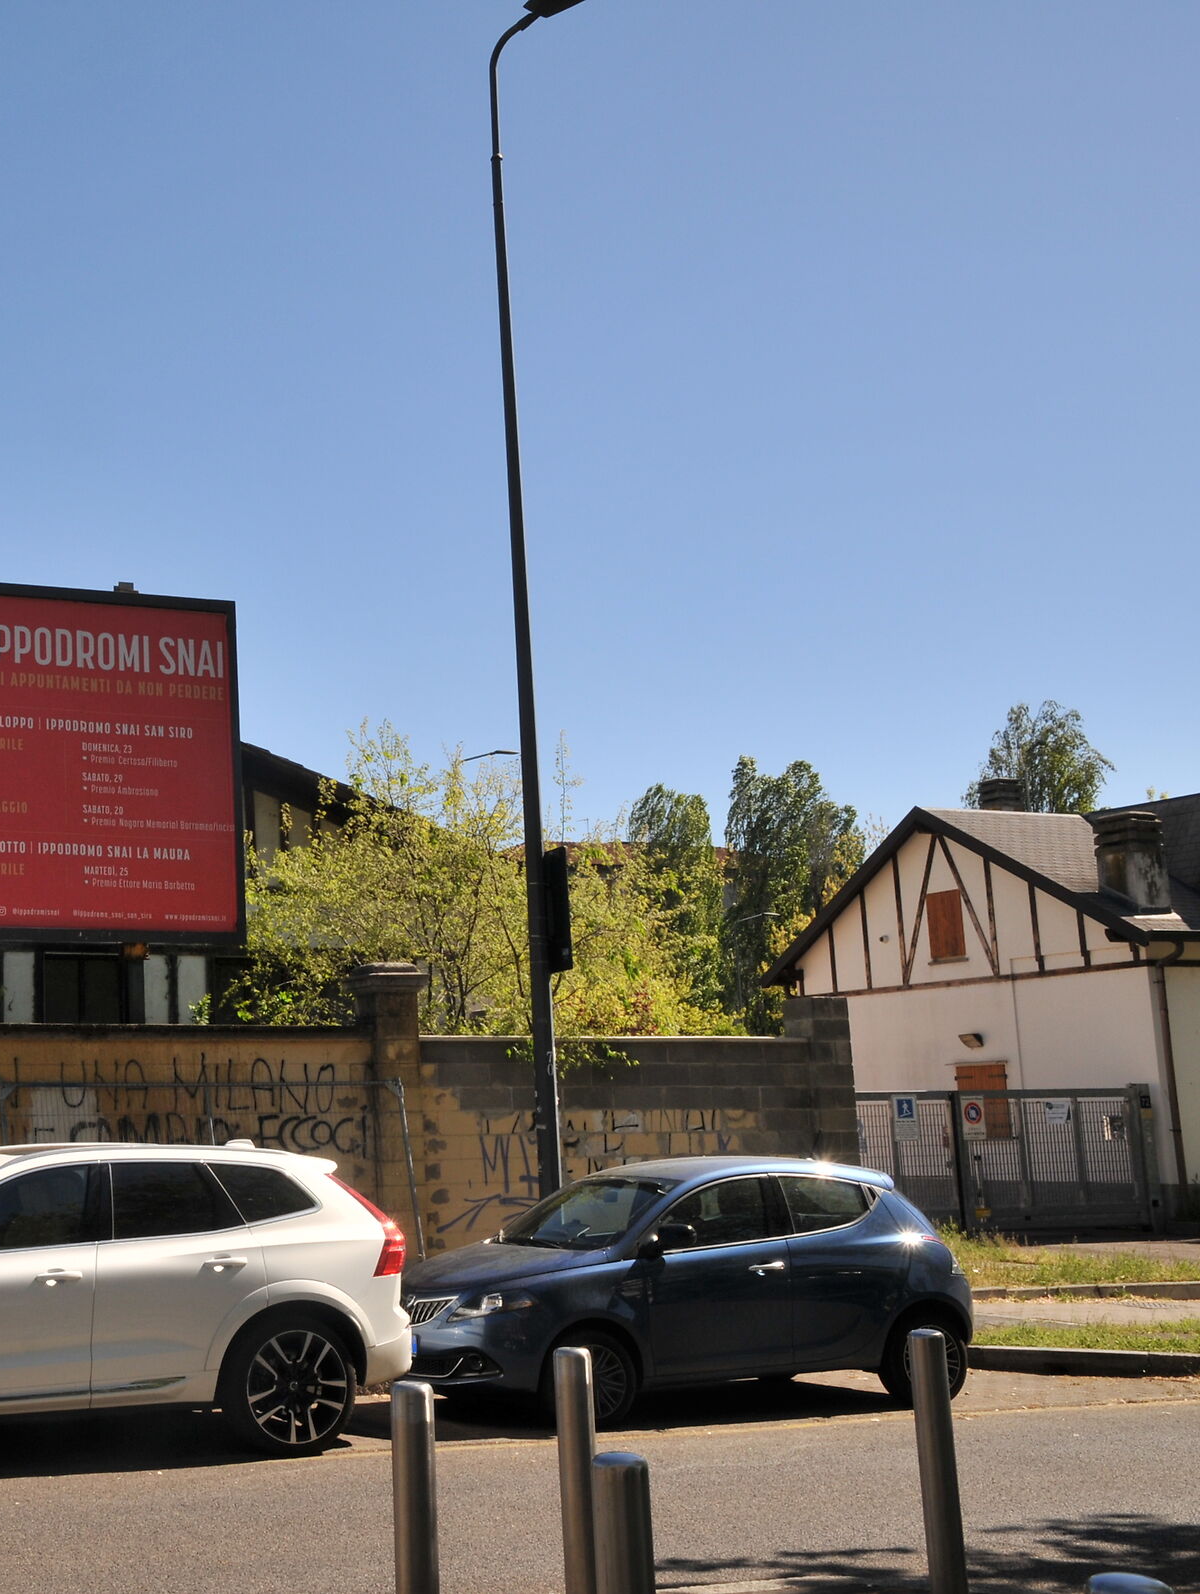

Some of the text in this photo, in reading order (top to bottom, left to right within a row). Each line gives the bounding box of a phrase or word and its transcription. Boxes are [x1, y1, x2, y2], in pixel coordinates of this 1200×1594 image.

[159, 636, 224, 678] SNAI
[10, 671, 110, 693] APPUNTAMENTI
[116, 680, 132, 695] DA
[138, 681, 163, 697] NON
[169, 684, 224, 701] PERDERE
[46, 718, 111, 735] IPPODROMO
[115, 723, 140, 736] SNAI
[144, 724, 164, 737] SAN
[169, 726, 193, 739] SIRO
[123, 744, 133, 754] 23
[90, 754, 115, 765] Premio
[91, 785, 115, 794] Premio
[114, 806, 124, 815] 20
[91, 817, 116, 826] Premio
[38, 842, 103, 857] IPPODROMO
[107, 844, 132, 859] SNAI
[137, 847, 149, 859] LA
[153, 847, 191, 861] MAURA
[119, 867, 128, 876] 25
[92, 878, 117, 888] Premio
[173, 1051, 336, 1116] MILANO
